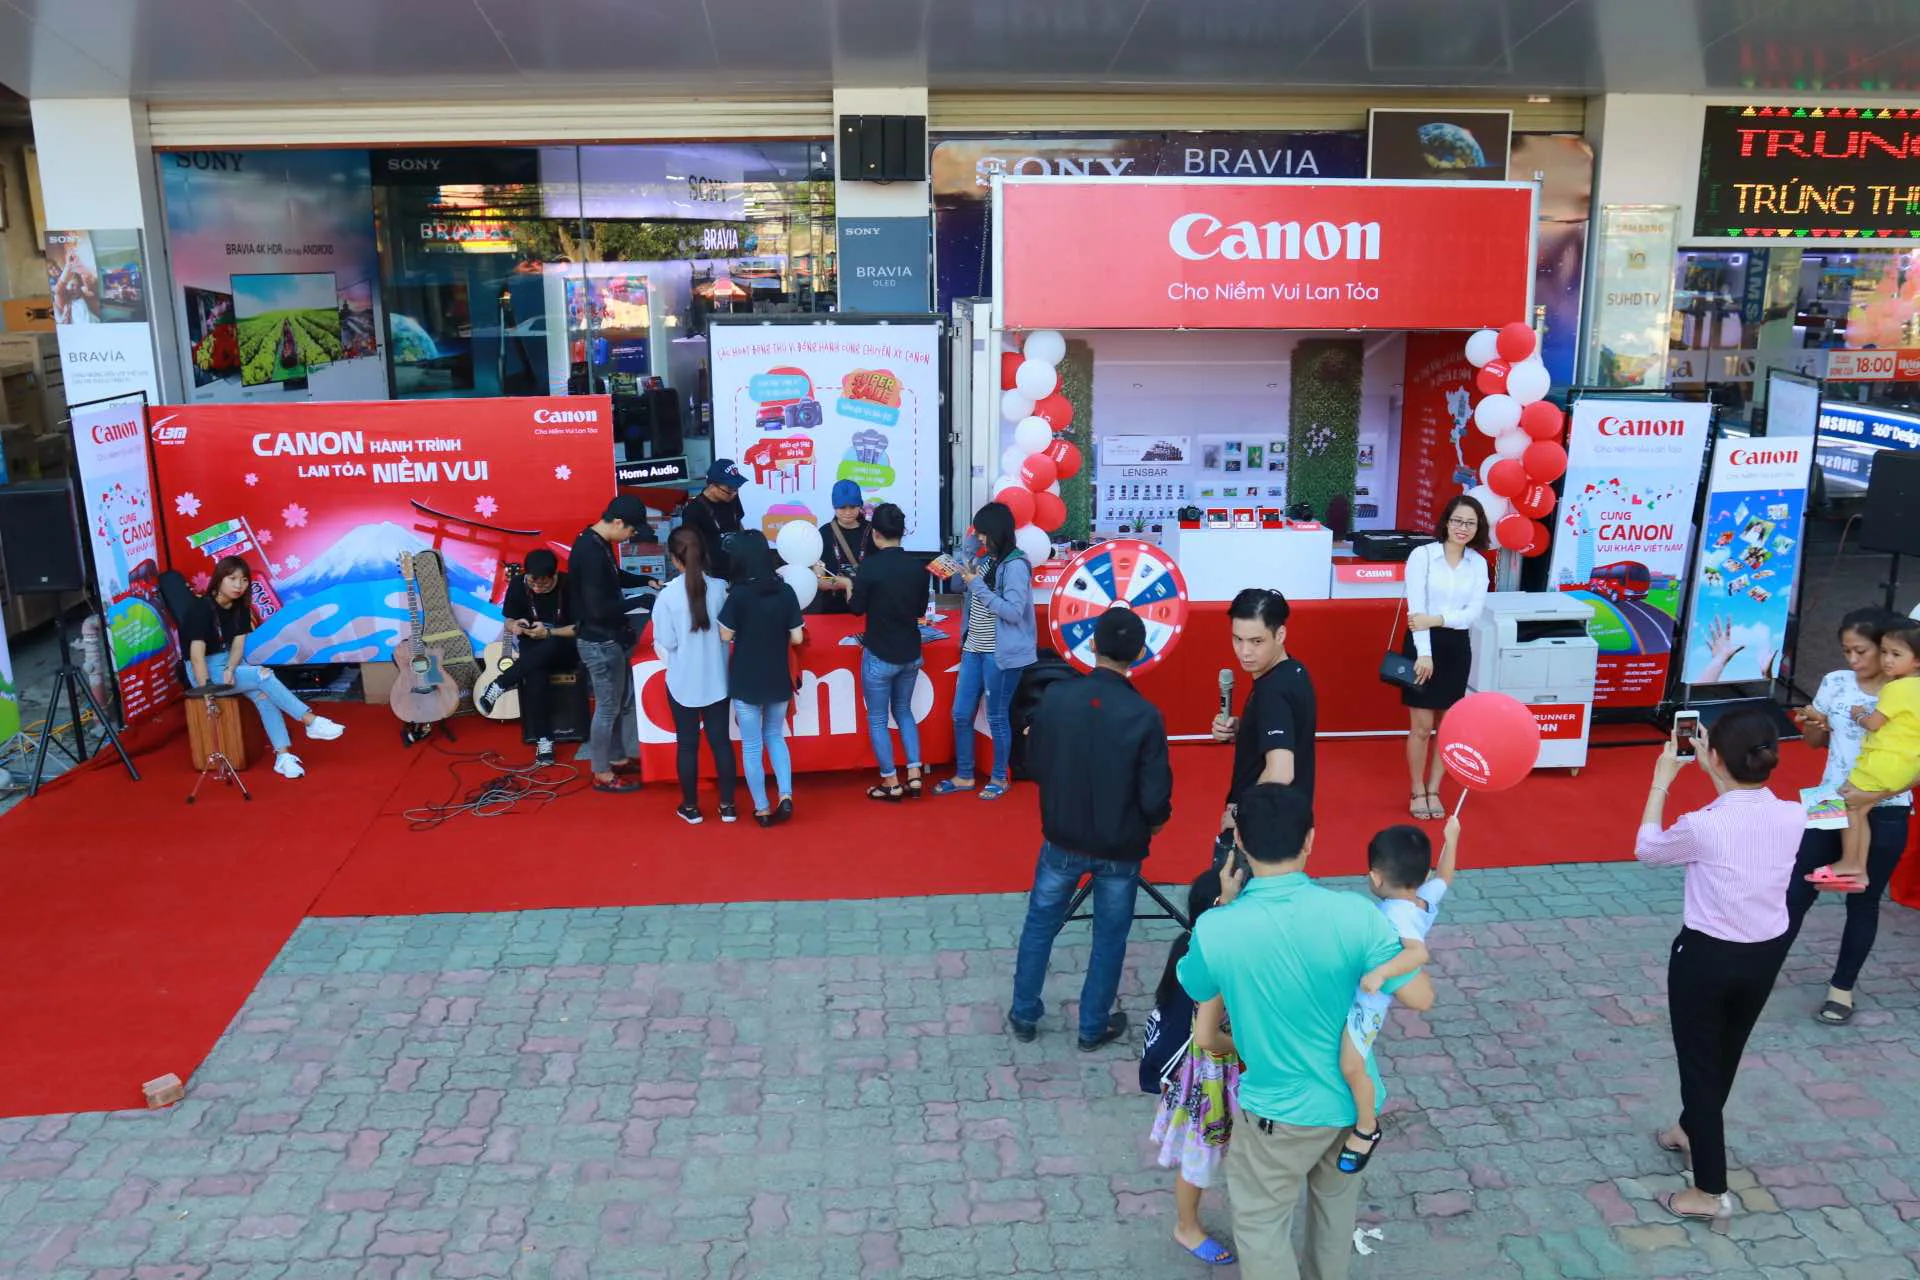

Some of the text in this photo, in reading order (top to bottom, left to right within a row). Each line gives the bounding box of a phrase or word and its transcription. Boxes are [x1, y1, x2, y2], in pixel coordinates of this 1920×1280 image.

[1737, 128, 1920, 159] TRUN
[176, 150, 243, 172] SONY
[387, 158, 440, 171] SONY
[1185, 147, 1320, 175] BRAVIA
[976, 157, 1135, 187] SONY
[1734, 177, 1857, 215] TRÚNG
[703, 228, 739, 250] BRAVIA
[845, 227, 880, 236] SONY
[1168, 212, 1381, 261] Canon
[225, 243, 255, 256] BRAVIA
[856, 266, 912, 278] BRAVIA
[872, 279, 896, 287] OLED
[1168, 282, 1209, 300] Cho
[1271, 283, 1301, 300] Vui
[1306, 284, 1340, 300] Lan
[1644, 292, 1661, 305] TV
[68, 350, 126, 363] BRAVIA
[1855, 357, 1893, 373] 18:00
[534, 409, 598, 424] Canon
[1819, 414, 1864, 435] MSUNG
[91, 420, 138, 445] Canon
[1598, 416, 1685, 437] Canon
[252, 431, 461, 456] CANON HÀNH TRÌNH
[1729, 449, 1799, 466] Canon
[298, 464, 329, 478] LAN
[372, 455, 438, 483] NIỀM
[441, 460, 488, 482] VUI
[619, 465, 679, 480] Home Audio
[1122, 467, 1168, 477] LENSBAR
[122, 520, 153, 545] CANO
[1598, 523, 1674, 541] CANON
[1034, 574, 1059, 583] Can
[1355, 568, 1393, 578] Canon
